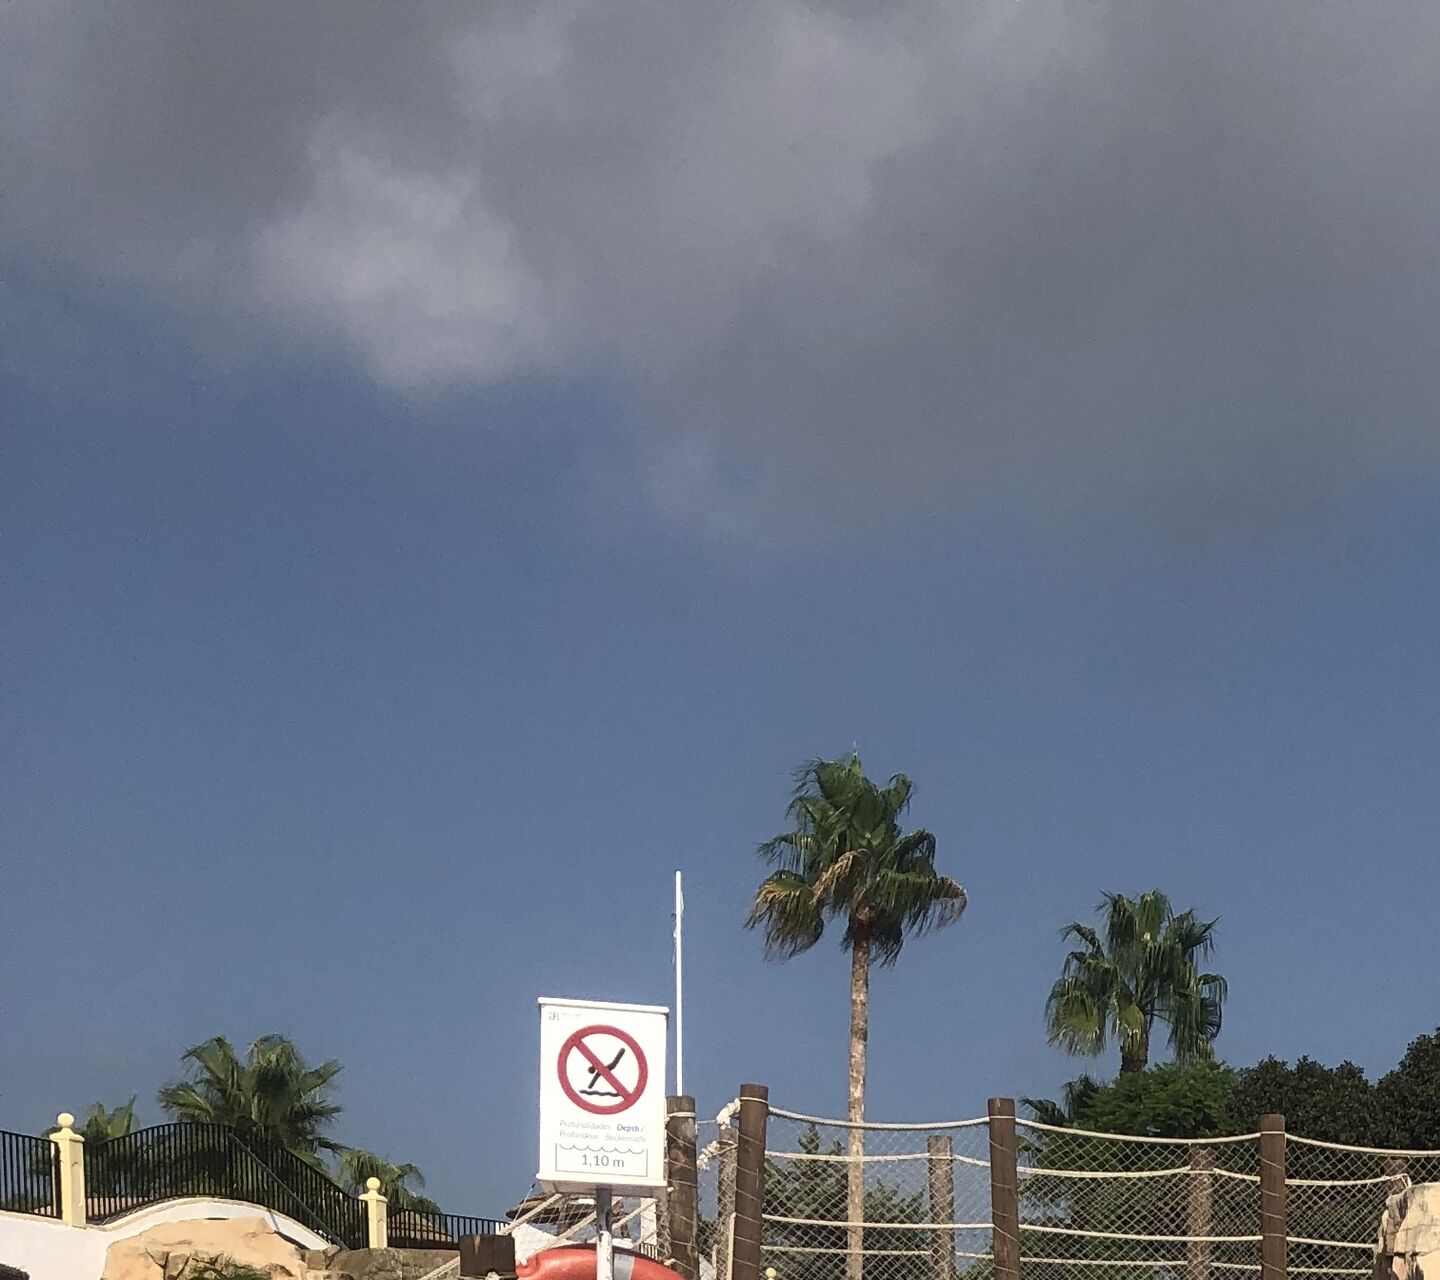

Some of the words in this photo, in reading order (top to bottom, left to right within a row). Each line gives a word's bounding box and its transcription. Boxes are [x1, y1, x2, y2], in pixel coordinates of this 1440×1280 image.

[617, 1123, 640, 1133] Depth
[582, 1154, 610, 1168] 1,10
[612, 1159, 625, 1168] m
